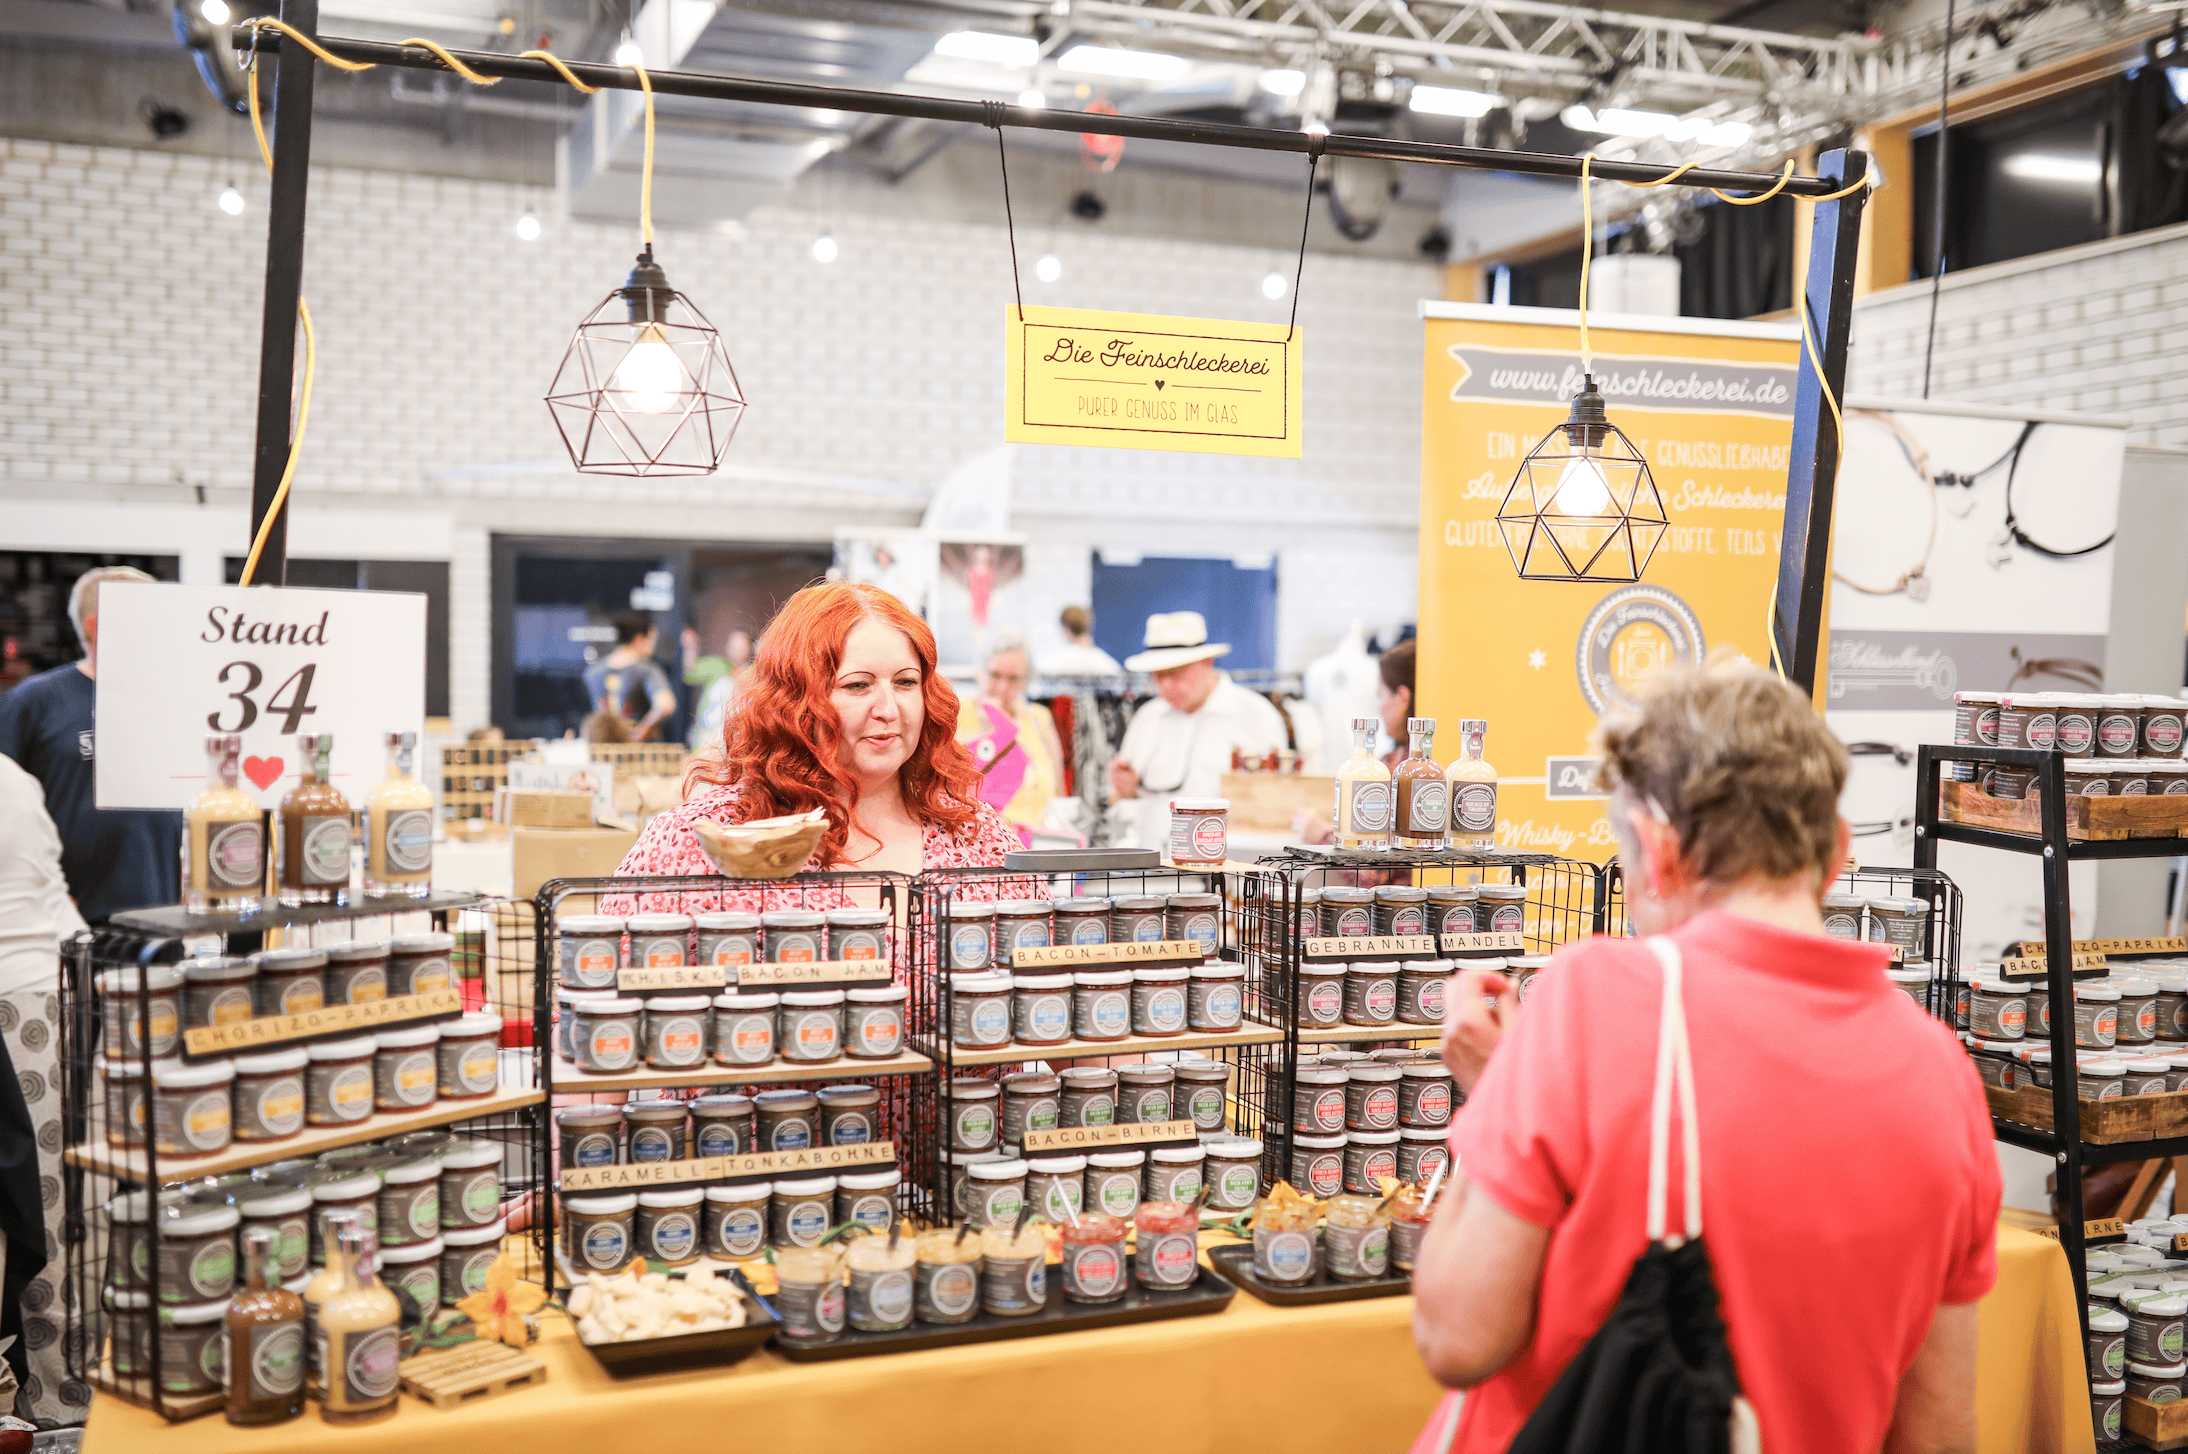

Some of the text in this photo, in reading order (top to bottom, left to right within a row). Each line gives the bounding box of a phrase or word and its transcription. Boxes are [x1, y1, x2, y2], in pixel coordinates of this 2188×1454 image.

[1043, 338, 1271, 375] Die Feinschleckerei
[1489, 364, 1790, 404] www.fenschleckerei.de
[1078, 395, 1239, 424] PURER GENUSS IM GLAS
[1487, 431, 1516, 458] EIN
[1658, 439, 1791, 471] GENUSSLIEBHABE
[1673, 478, 1786, 511] Schleckere
[200, 605, 330, 646] Stand
[208, 660, 318, 736] 34
[1018, 943, 1200, 962] BACON-TOMATE
[1309, 935, 1520, 953] GEBRANNTE MANDEL
[2025, 938, 2186, 954] CHIZO-PAPRIKA
[620, 963, 889, 985] WHISKY BACON JAM
[2076, 956, 2107, 968] JAM
[191, 994, 459, 1047] CHORIZO-PAPRIKA
[1028, 1122, 1193, 1147] BACON-BIRNE
[563, 1145, 892, 1187] KARAMELL-TONKABOHNE
